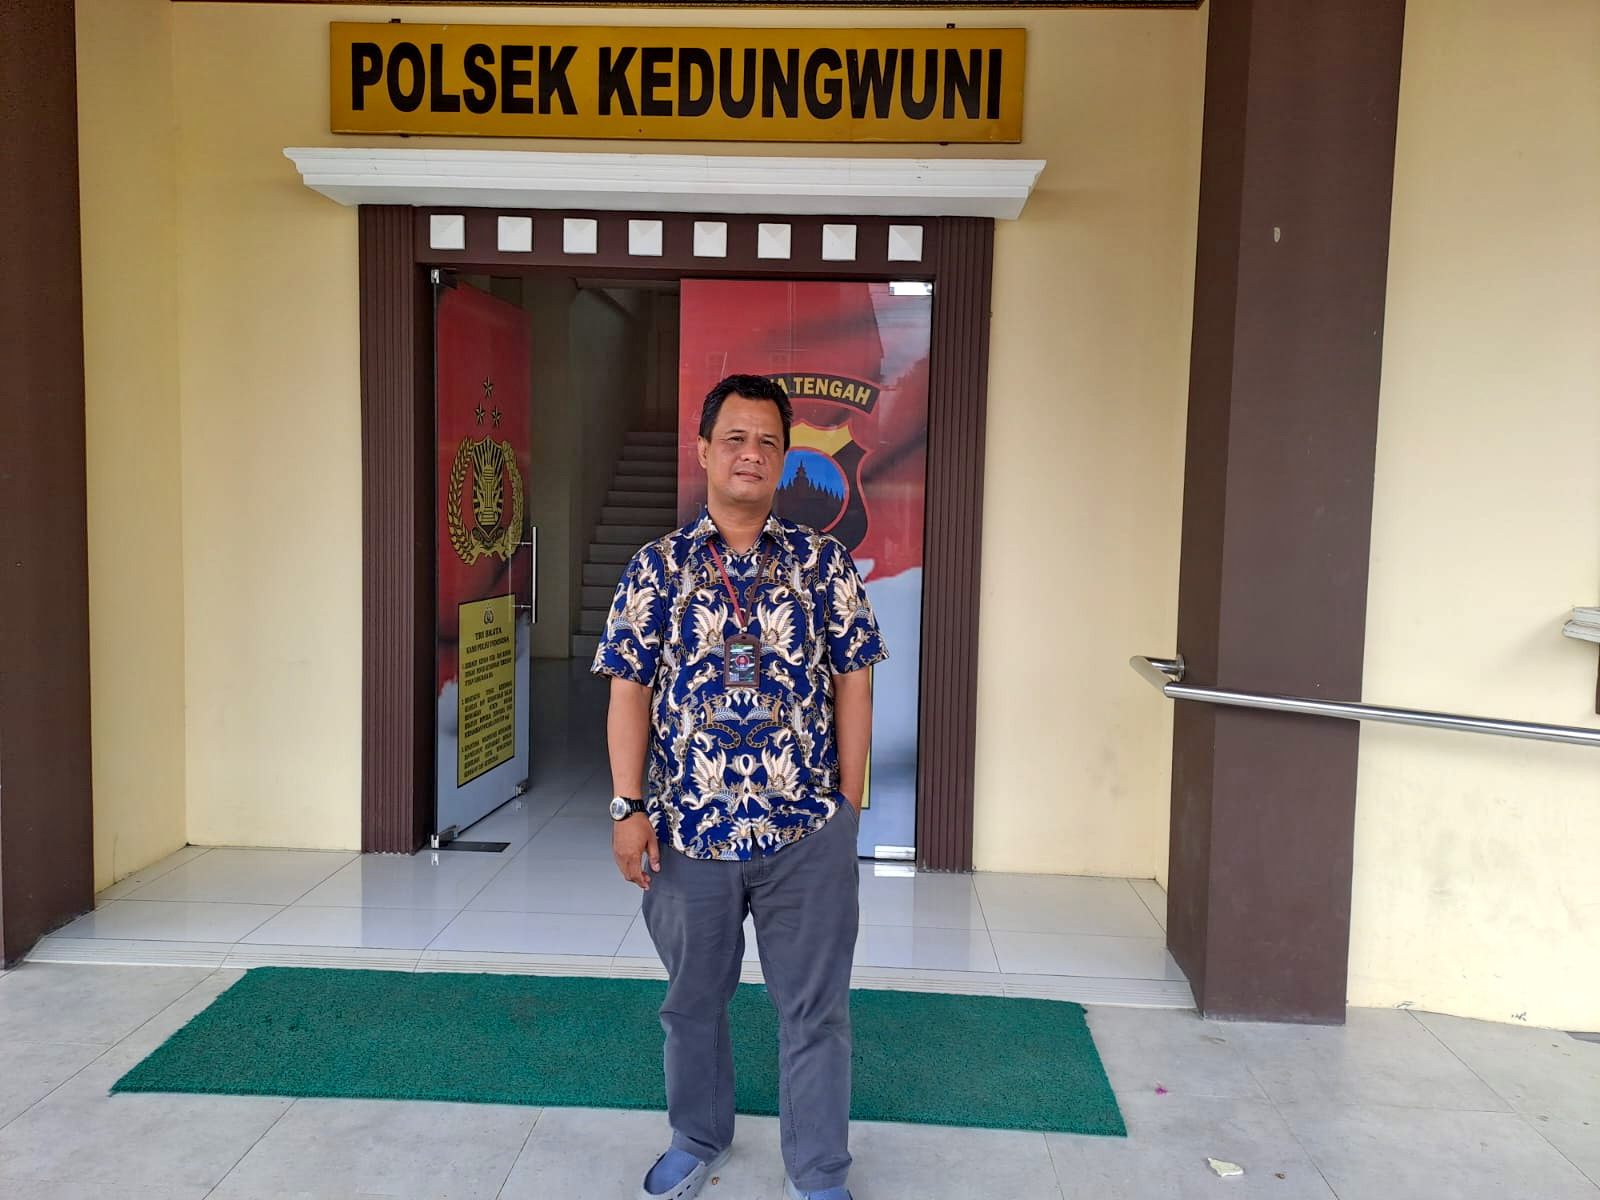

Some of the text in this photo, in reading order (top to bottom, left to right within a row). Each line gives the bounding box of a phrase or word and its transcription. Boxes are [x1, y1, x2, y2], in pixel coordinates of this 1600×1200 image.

[351, 42, 1002, 120] POLSEK KEDUNGWUNI
[793, 377, 871, 405] TENGAH
